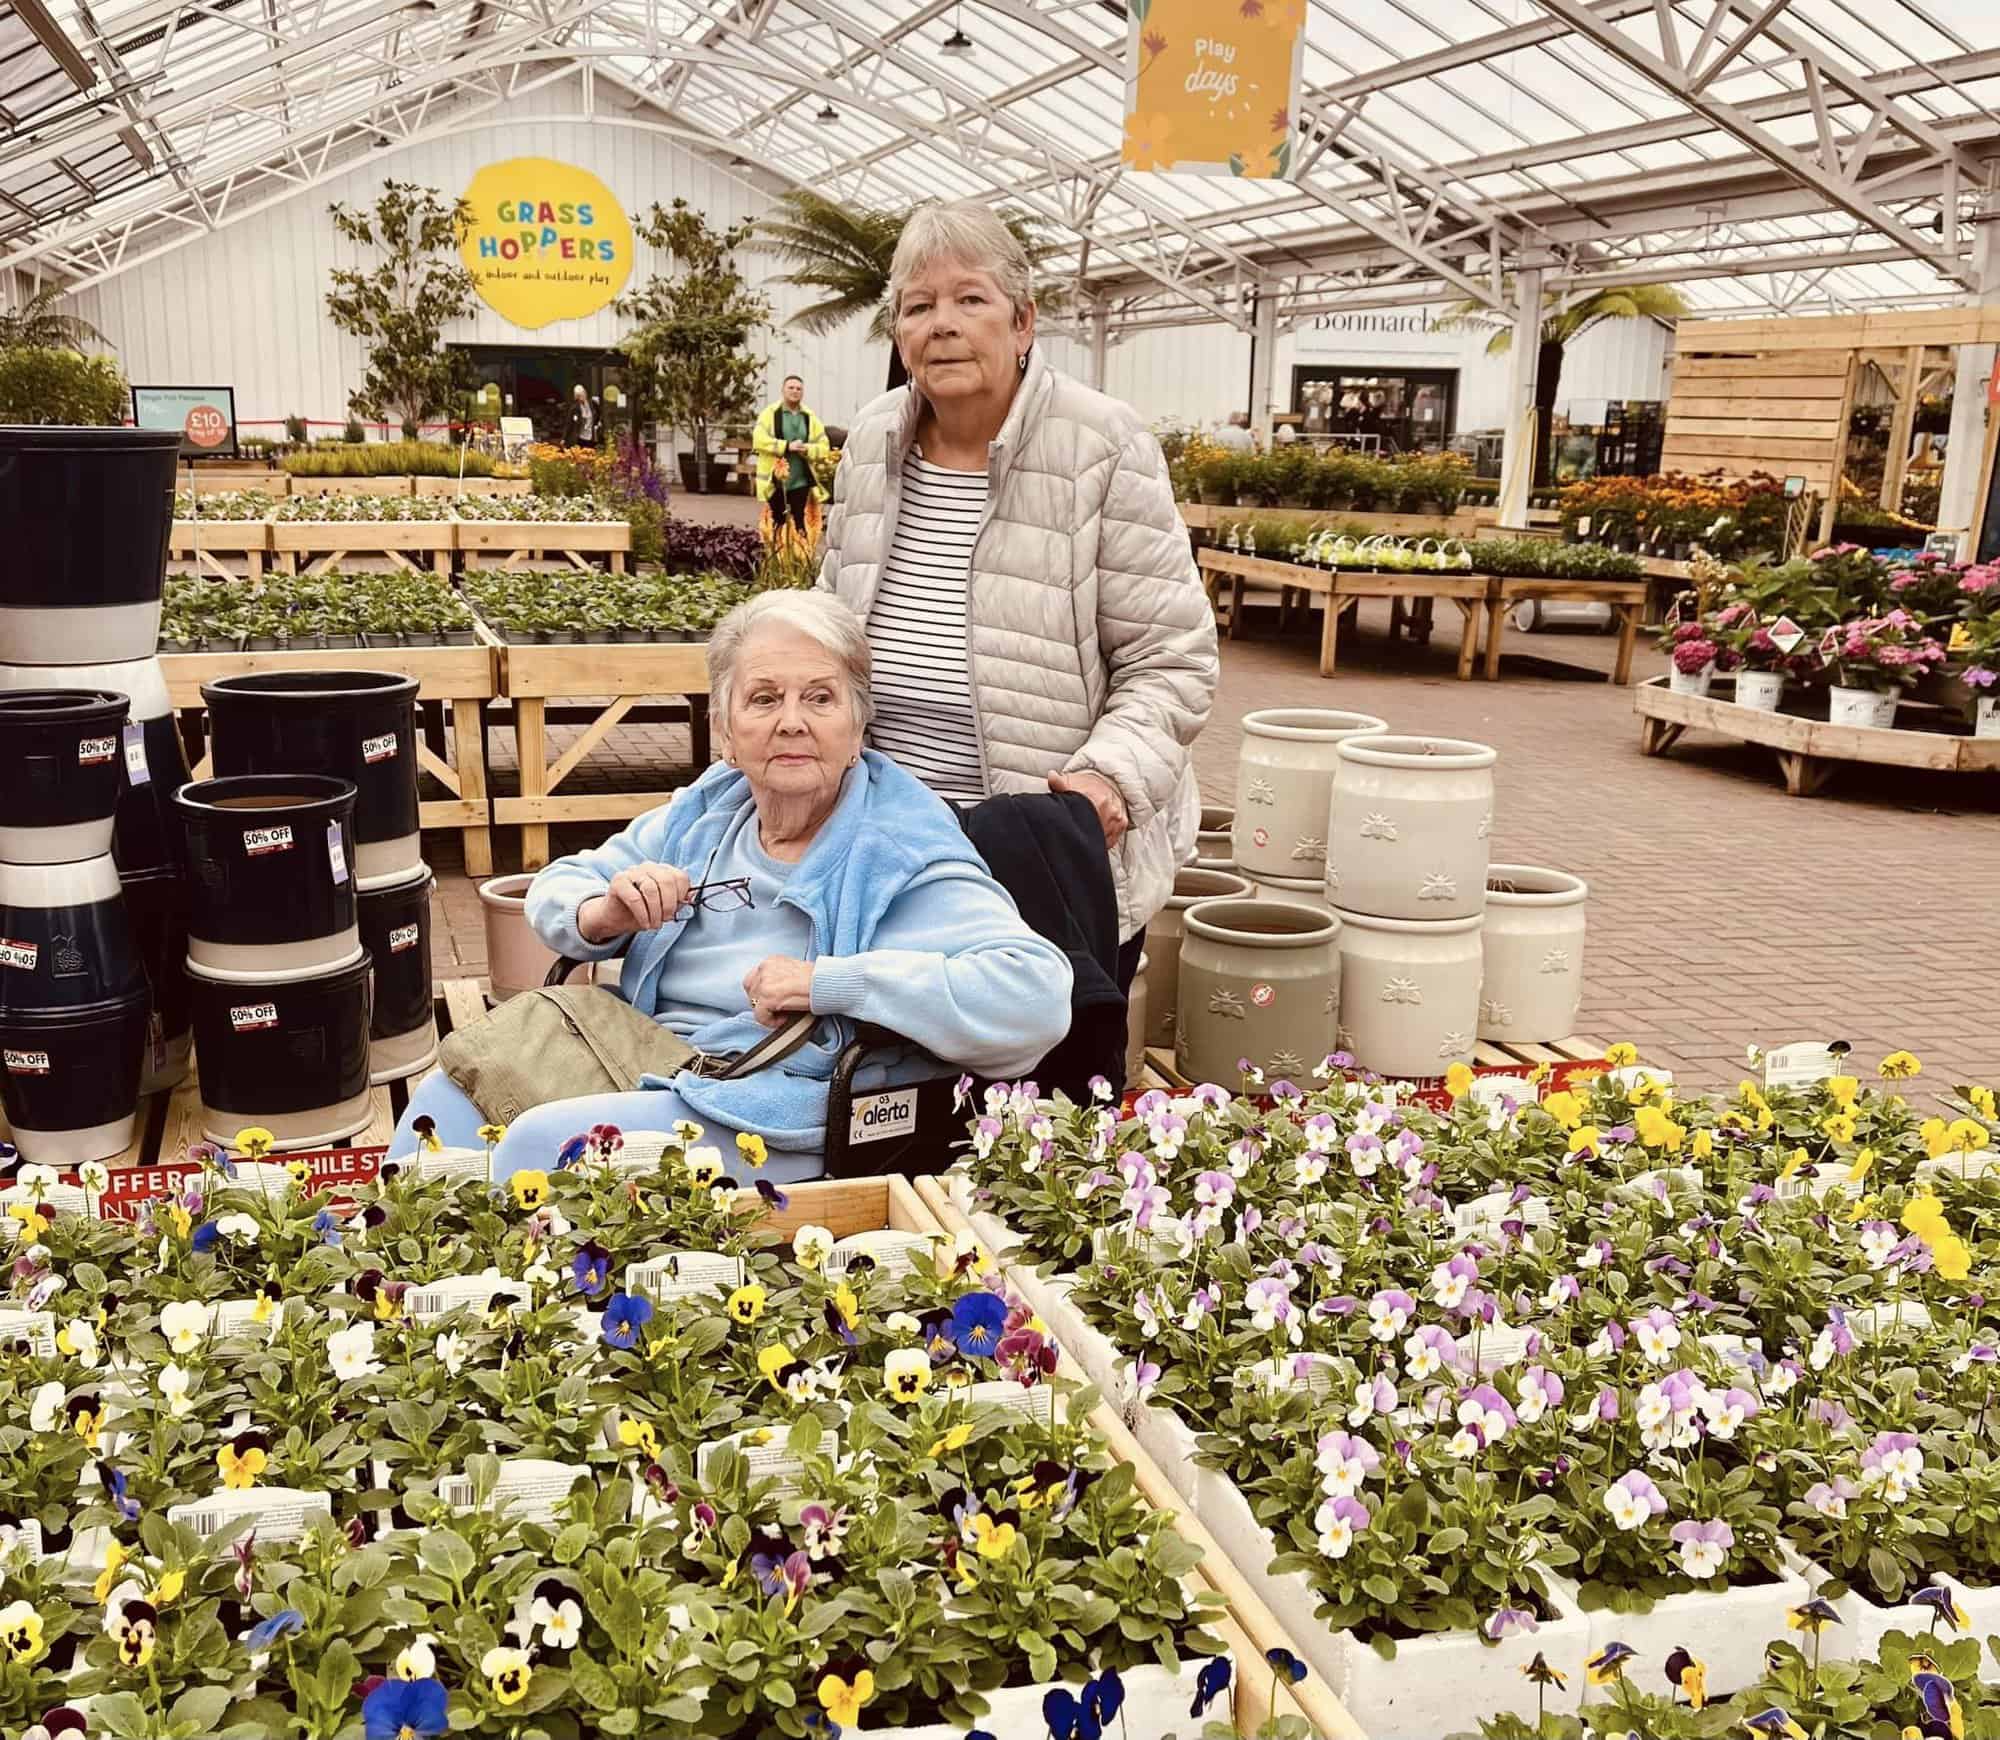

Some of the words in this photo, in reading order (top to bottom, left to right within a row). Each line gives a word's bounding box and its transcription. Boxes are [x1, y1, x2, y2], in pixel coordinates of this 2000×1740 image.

[1194, 37, 1236, 63] Play
[1184, 61, 1239, 101] days
[497, 200, 593, 224] GRASS
[479, 227, 615, 261] HOPPERS
[191, 411, 221, 428] £10
[245, 832, 268, 845] 50%
[271, 827, 290, 841] OFF
[231, 1009, 252, 1021] 50%
[255, 1006, 273, 1018] OFF
[27, 1054, 46, 1065] OFF
[879, 1095, 889, 1105] 03
[863, 1101, 909, 1126] alerta
[112, 1170, 184, 1195] FFER
